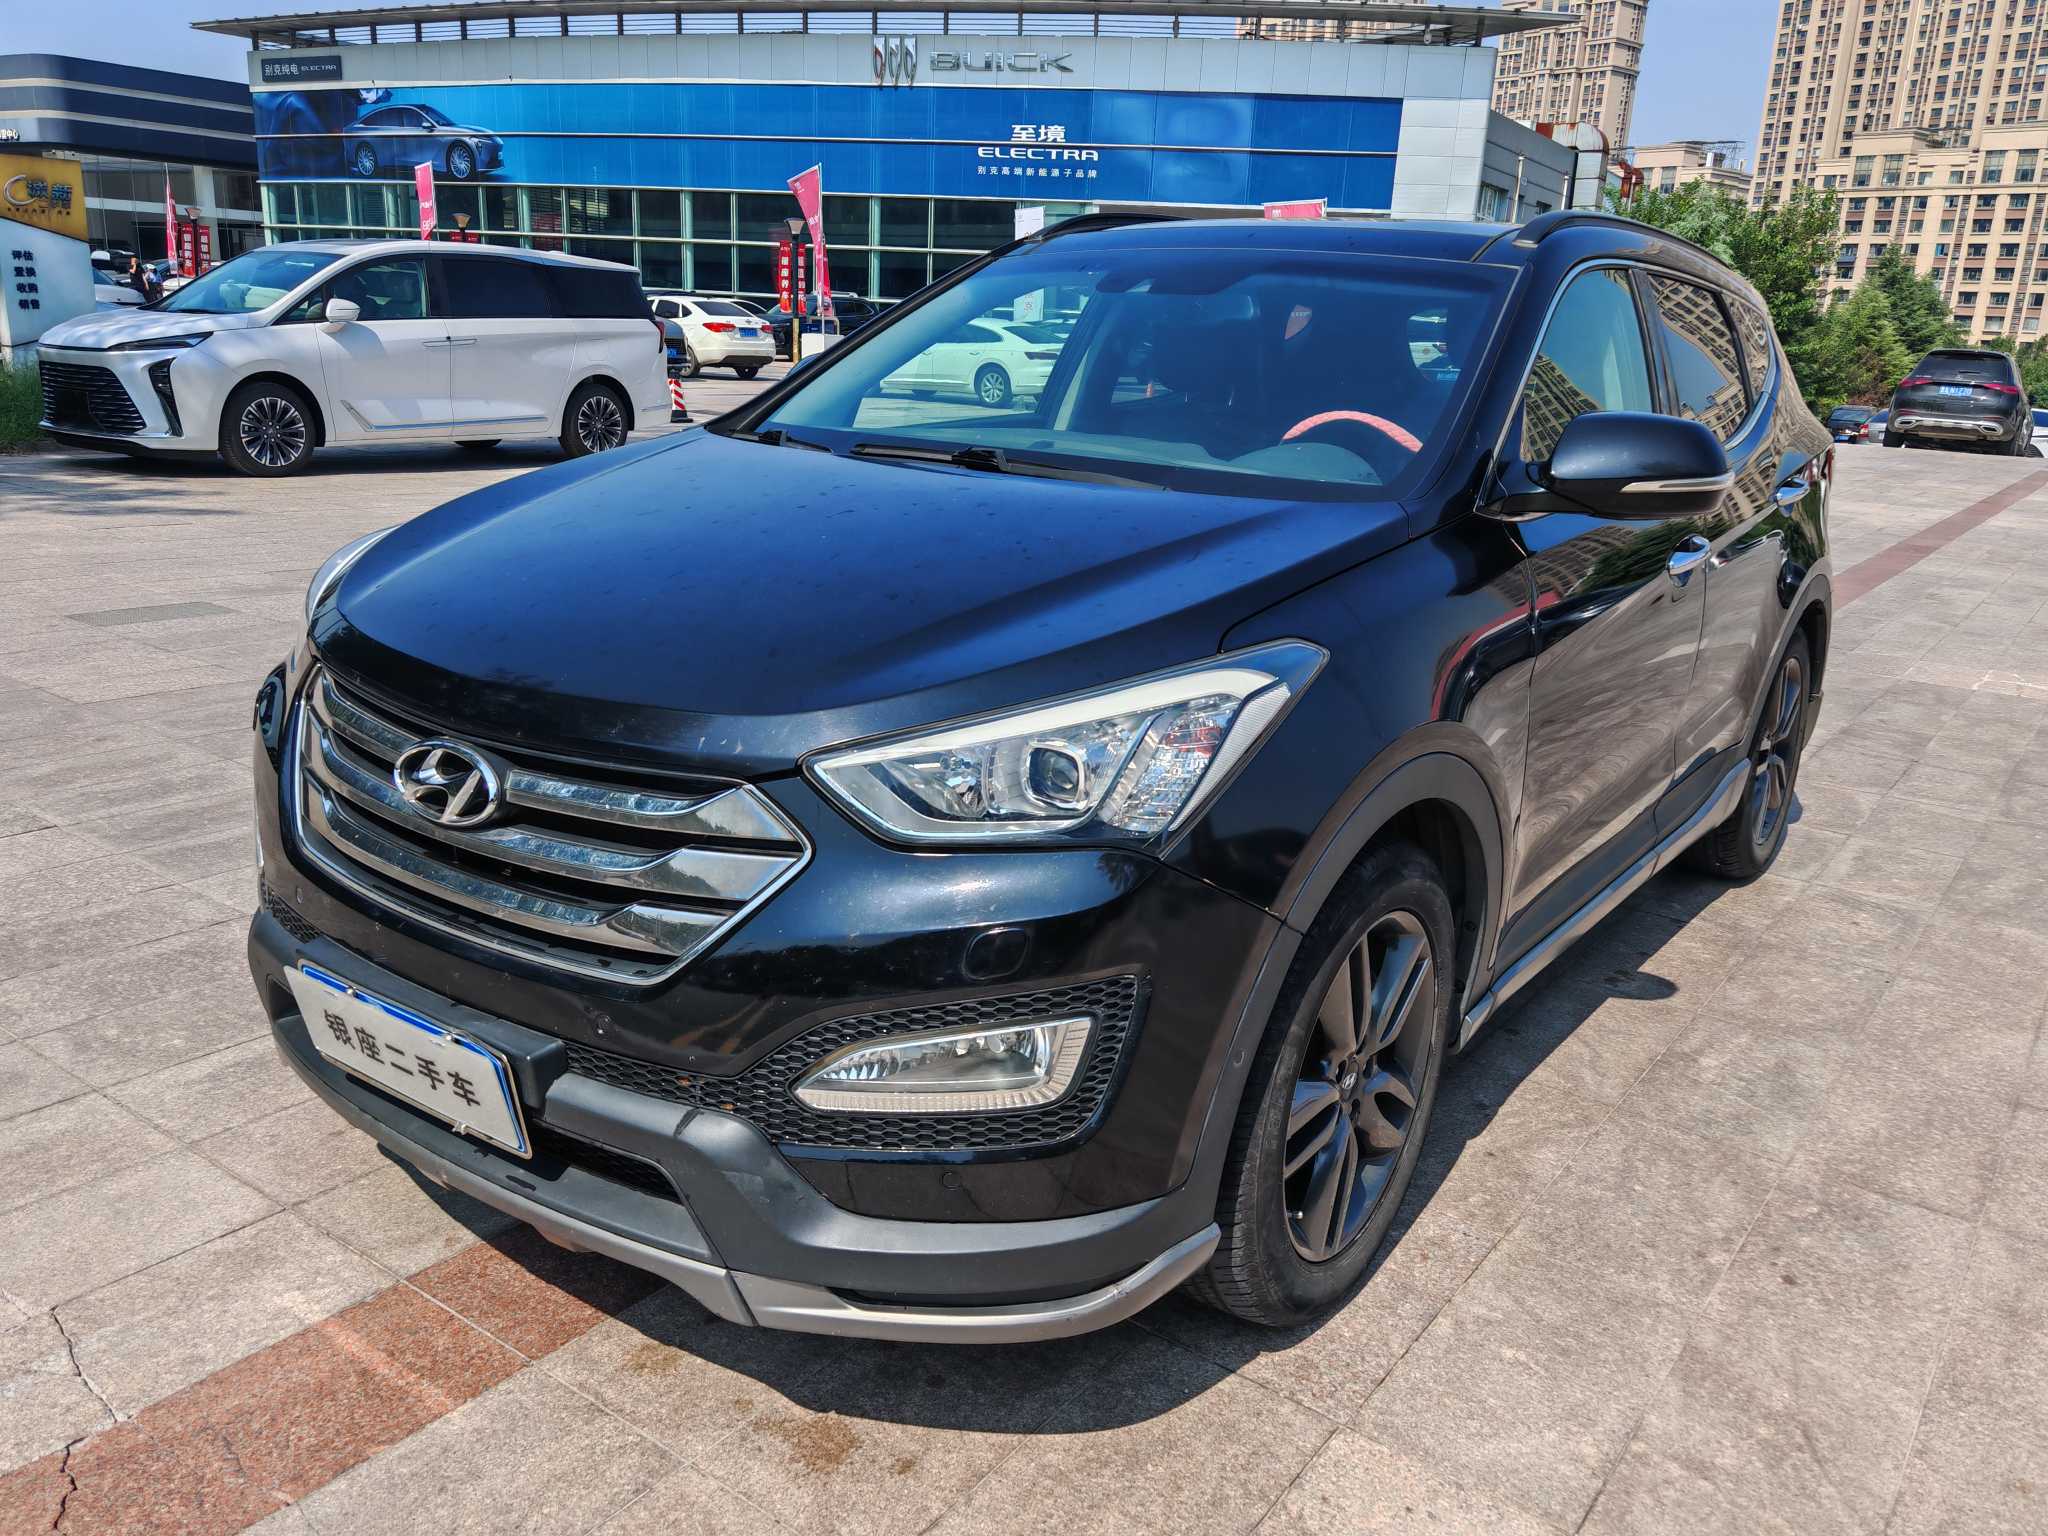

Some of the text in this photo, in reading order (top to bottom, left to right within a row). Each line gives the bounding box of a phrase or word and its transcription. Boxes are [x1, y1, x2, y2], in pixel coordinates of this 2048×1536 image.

[930, 51, 1074, 73] BUICK
[264, 63, 299, 76] 别克纯电
[1010, 124, 1066, 143] 至境
[977, 146, 1099, 161] ELECTRA
[977, 165, 1098, 179] 别克高端新能源子品牌
[11, 250, 34, 261] 评估
[14, 266, 37, 277] 置换
[16, 282, 39, 294] 收购
[18, 299, 41, 310] 销售
[323, 1008, 482, 1108] 银座二手车
